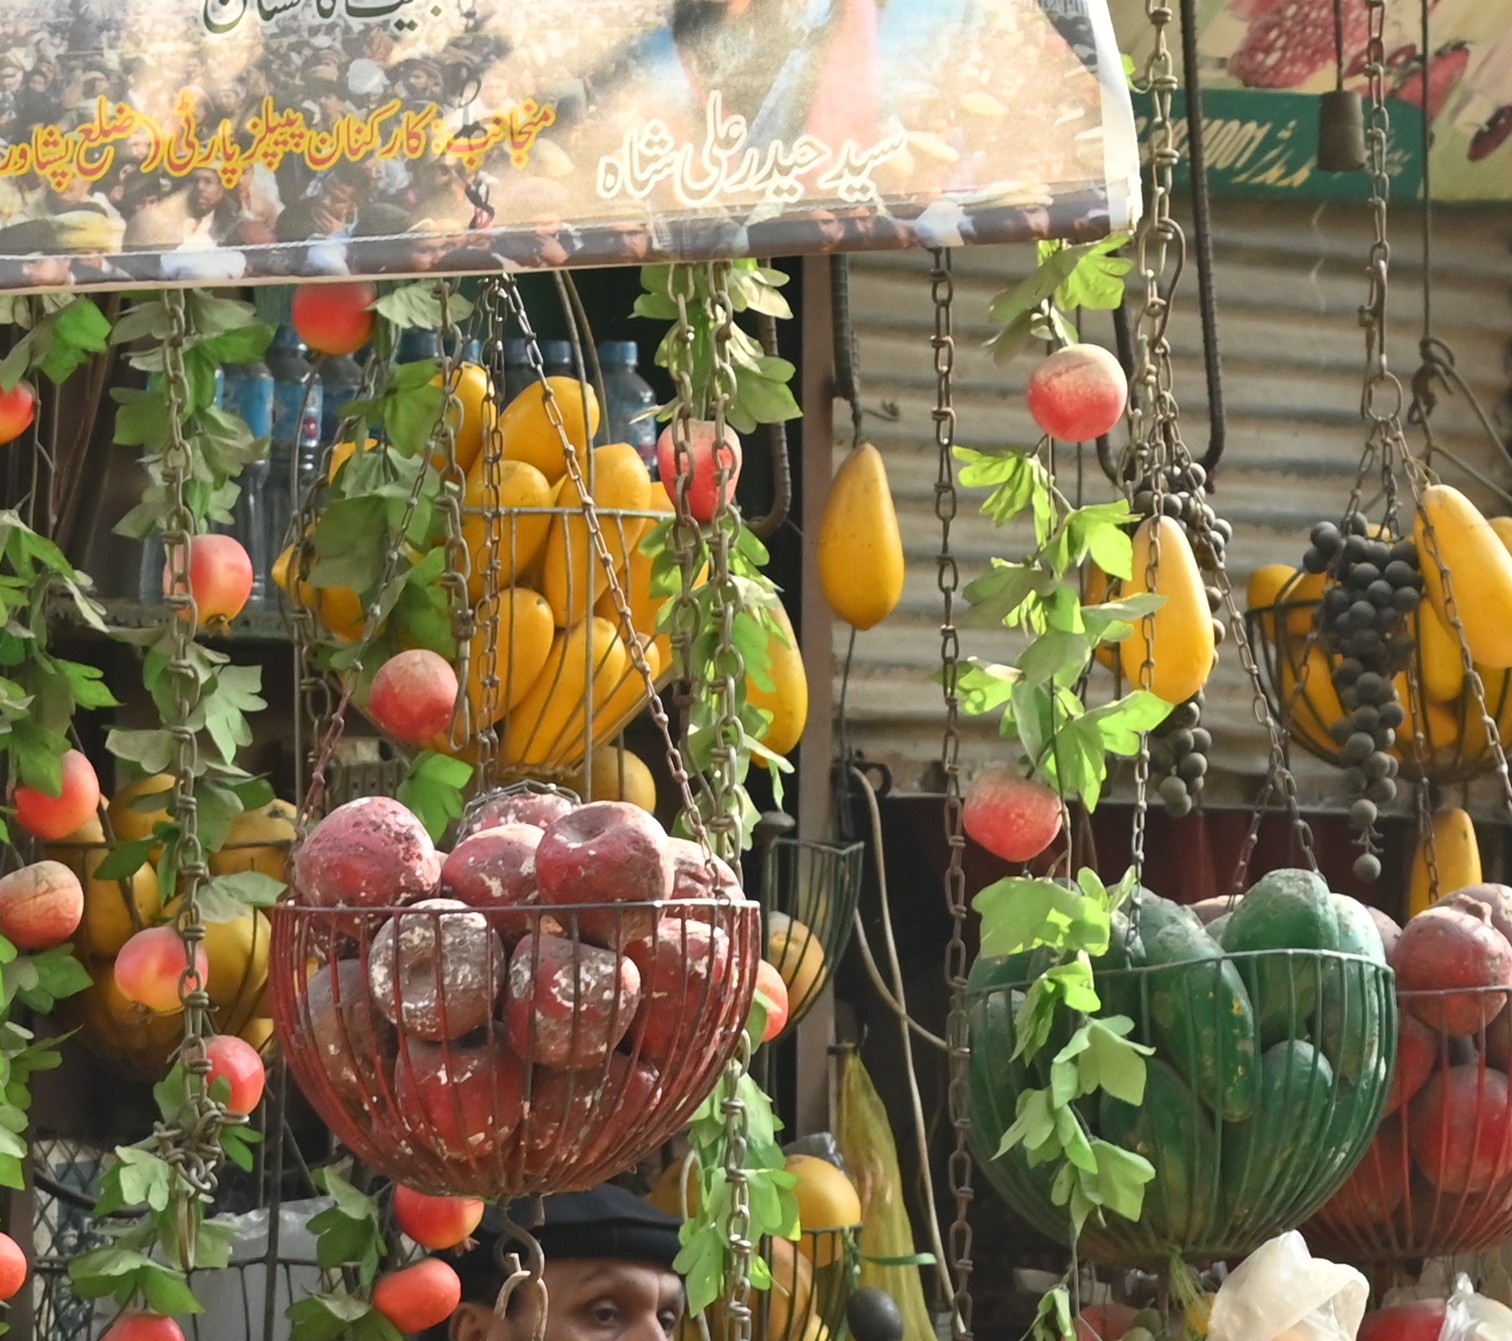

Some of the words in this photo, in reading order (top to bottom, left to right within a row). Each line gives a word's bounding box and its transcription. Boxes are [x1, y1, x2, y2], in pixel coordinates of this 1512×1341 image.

[164, 91, 242, 190] پارٹی
[306, 97, 441, 172] کارکنان
[596, 117, 676, 200] شاہ
[673, 88, 749, 208] علی
[725, 133, 833, 204] حیدر
[818, 126, 912, 203] سید
